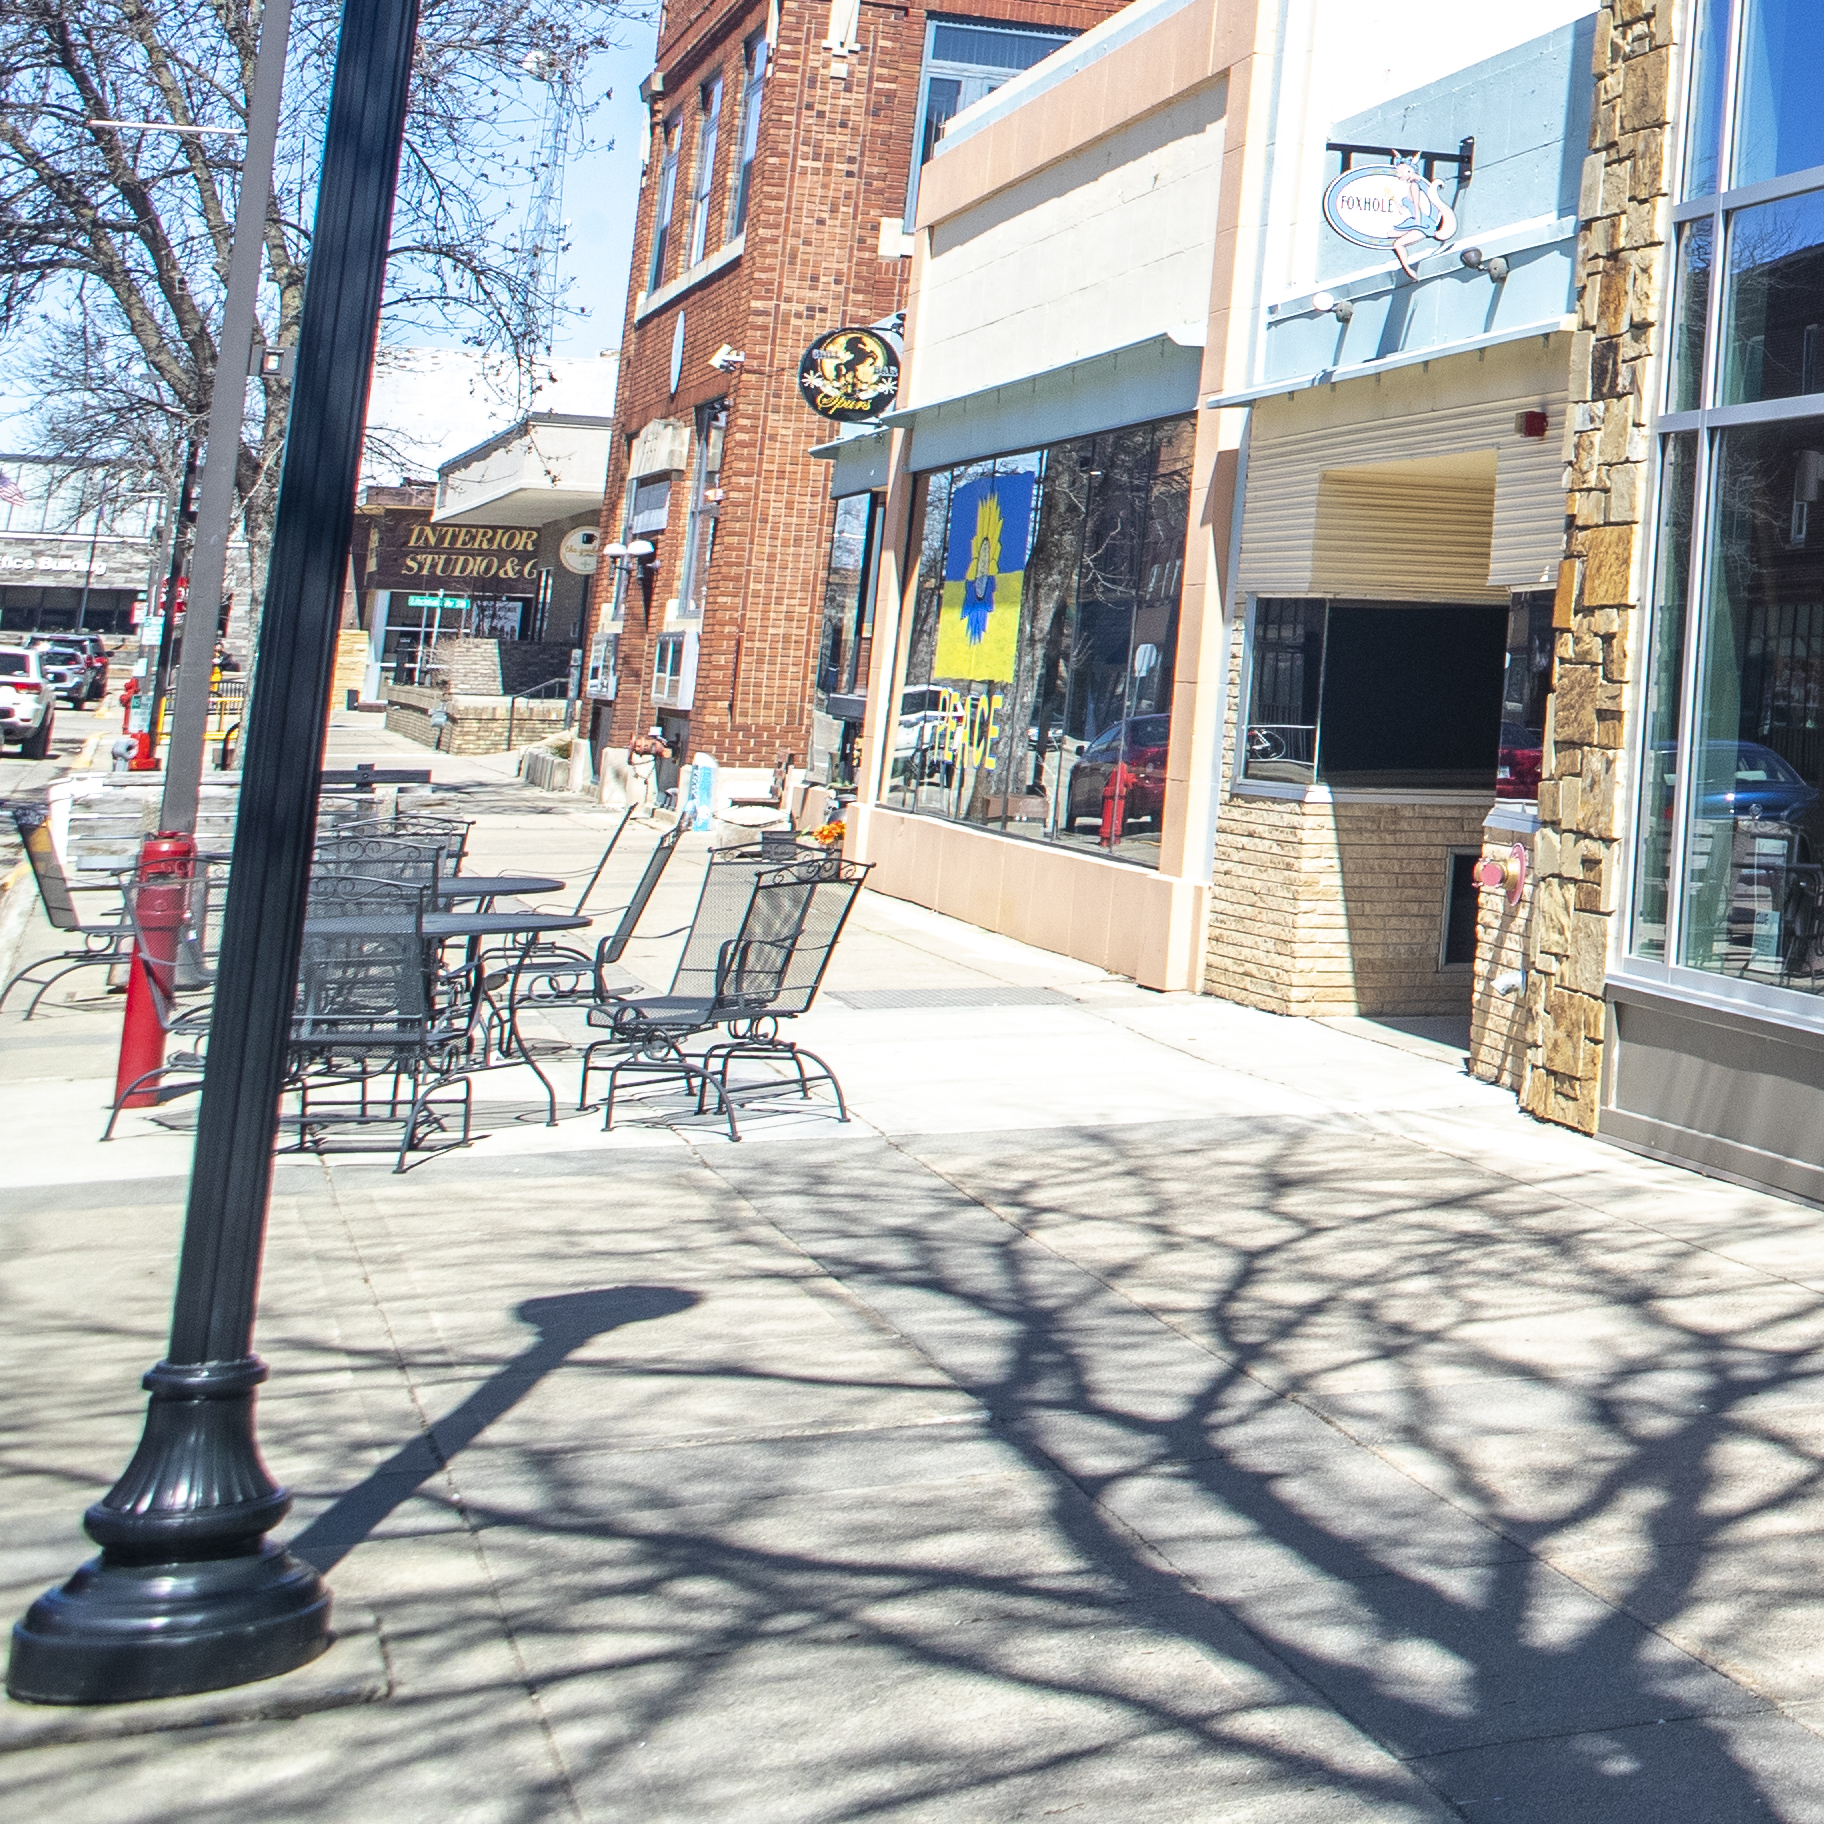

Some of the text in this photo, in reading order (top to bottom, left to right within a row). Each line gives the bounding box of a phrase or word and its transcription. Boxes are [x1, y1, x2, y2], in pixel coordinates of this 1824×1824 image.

[1341, 195, 1394, 212] FOXHOLE
[816, 393, 873, 414] Spurs
[407, 526, 539, 551] INTERIOR
[0, 555, 36, 570] fice
[401, 554, 498, 577] STUDIO
[498, 557, 522, 579] &
[933, 685, 1004, 772] PEACE
